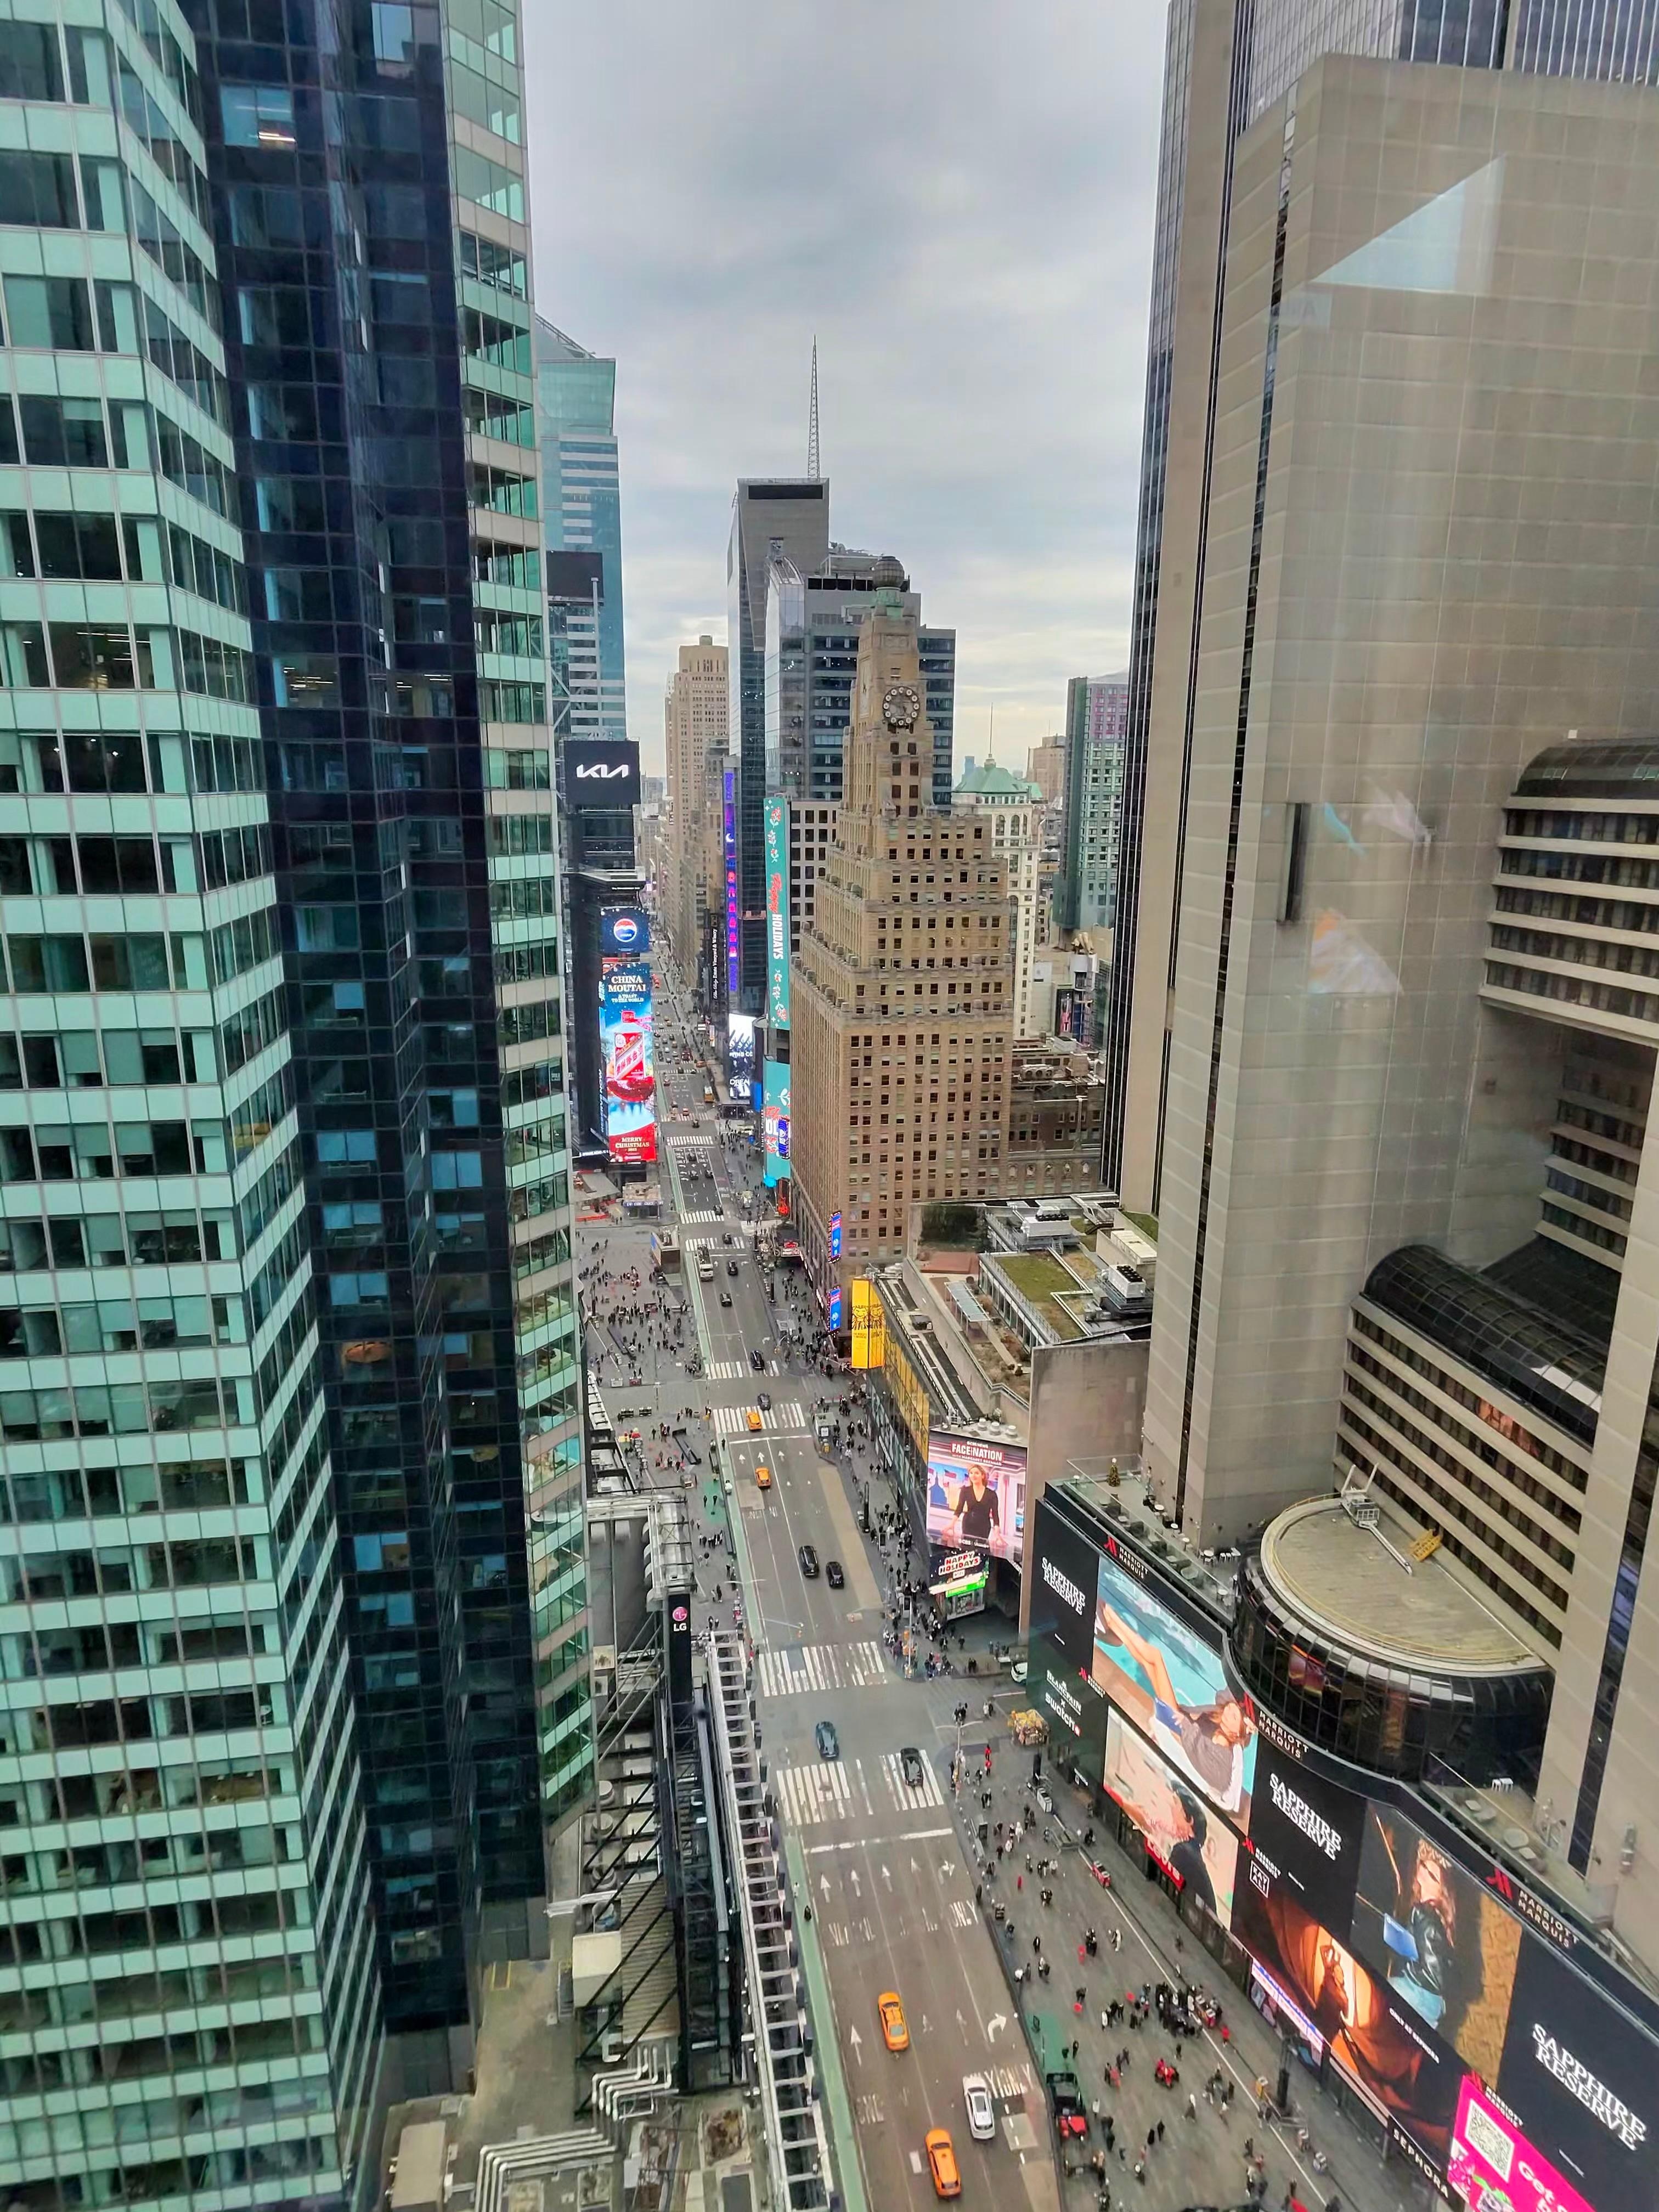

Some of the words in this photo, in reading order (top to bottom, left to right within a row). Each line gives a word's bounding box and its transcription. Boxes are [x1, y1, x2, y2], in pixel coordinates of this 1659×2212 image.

[576, 763, 629, 778] KIA
[772, 913, 783, 960] HOLIDAYS
[608, 984, 646, 992] MOUTAI
[611, 975, 643, 984] CHINA
[952, 1443, 971, 1455] FACE
[973, 1447, 1002, 1461] NATION
[940, 1558, 979, 1574] HOLIDAYS
[946, 1553, 973, 1565] HAPPY
[1119, 1553, 1144, 1579] MARQUIS
[1120, 1547, 1148, 1575] MARRIOTT
[1042, 1557, 1086, 1607] SAPPHIRE
[1043, 1569, 1083, 1616] RESERVE
[673, 1623, 687, 1632] LG
[1045, 1692, 1075, 1731] swatch
[1047, 1669, 1082, 1712] BLANCPAIN
[1259, 1720, 1301, 1758] MARQUIS
[1260, 1711, 1309, 1753] MARRIOTT
[1269, 1773, 1342, 1851] SAPPHIRE
[1272, 1789, 1336, 1861] RESERVE
[1518, 1899, 1569, 1949] MARQUIS
[1520, 1890, 1579, 1944] MARRIOTT
[1532, 2023, 1647, 2142] SAPPHIRE
[1535, 2044, 1637, 2151] RESERVE
[1393, 2128, 1448, 2198] SEPHORA
[1518, 2160, 1555, 2204] Get
